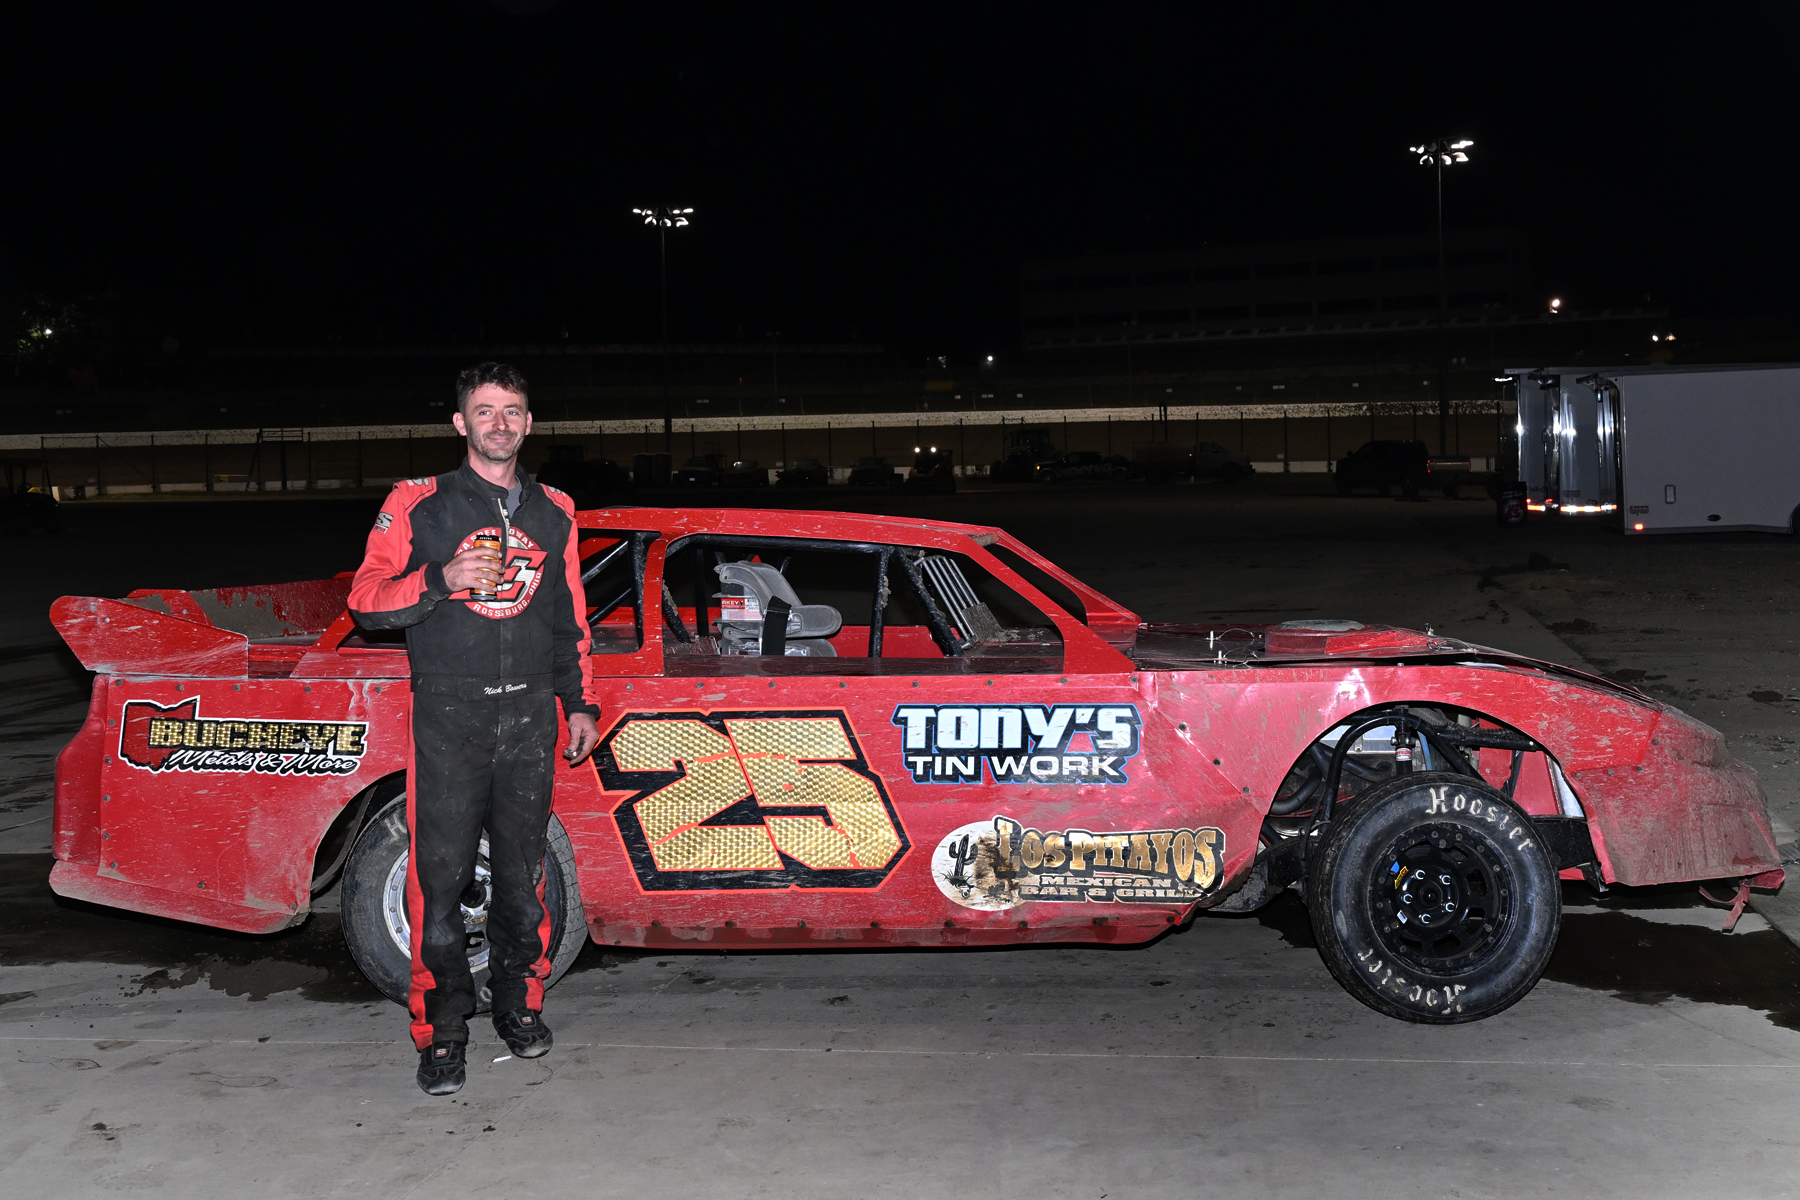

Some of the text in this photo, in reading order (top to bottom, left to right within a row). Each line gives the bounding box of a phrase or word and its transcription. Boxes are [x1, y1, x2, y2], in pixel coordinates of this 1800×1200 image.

[528, 572, 542, 596] OHIO
[484, 686, 503, 695] Nick
[149, 718, 364, 752] BUCKEYE
[168, 749, 357, 771] Metals & More
[907, 756, 1121, 776] TIN WORK
[604, 713, 906, 874] 25
[1425, 786, 1535, 851] Hoosier
[1019, 885, 1202, 898] BAR & GRILL
[1040, 876, 1172, 888] MEXICAN
